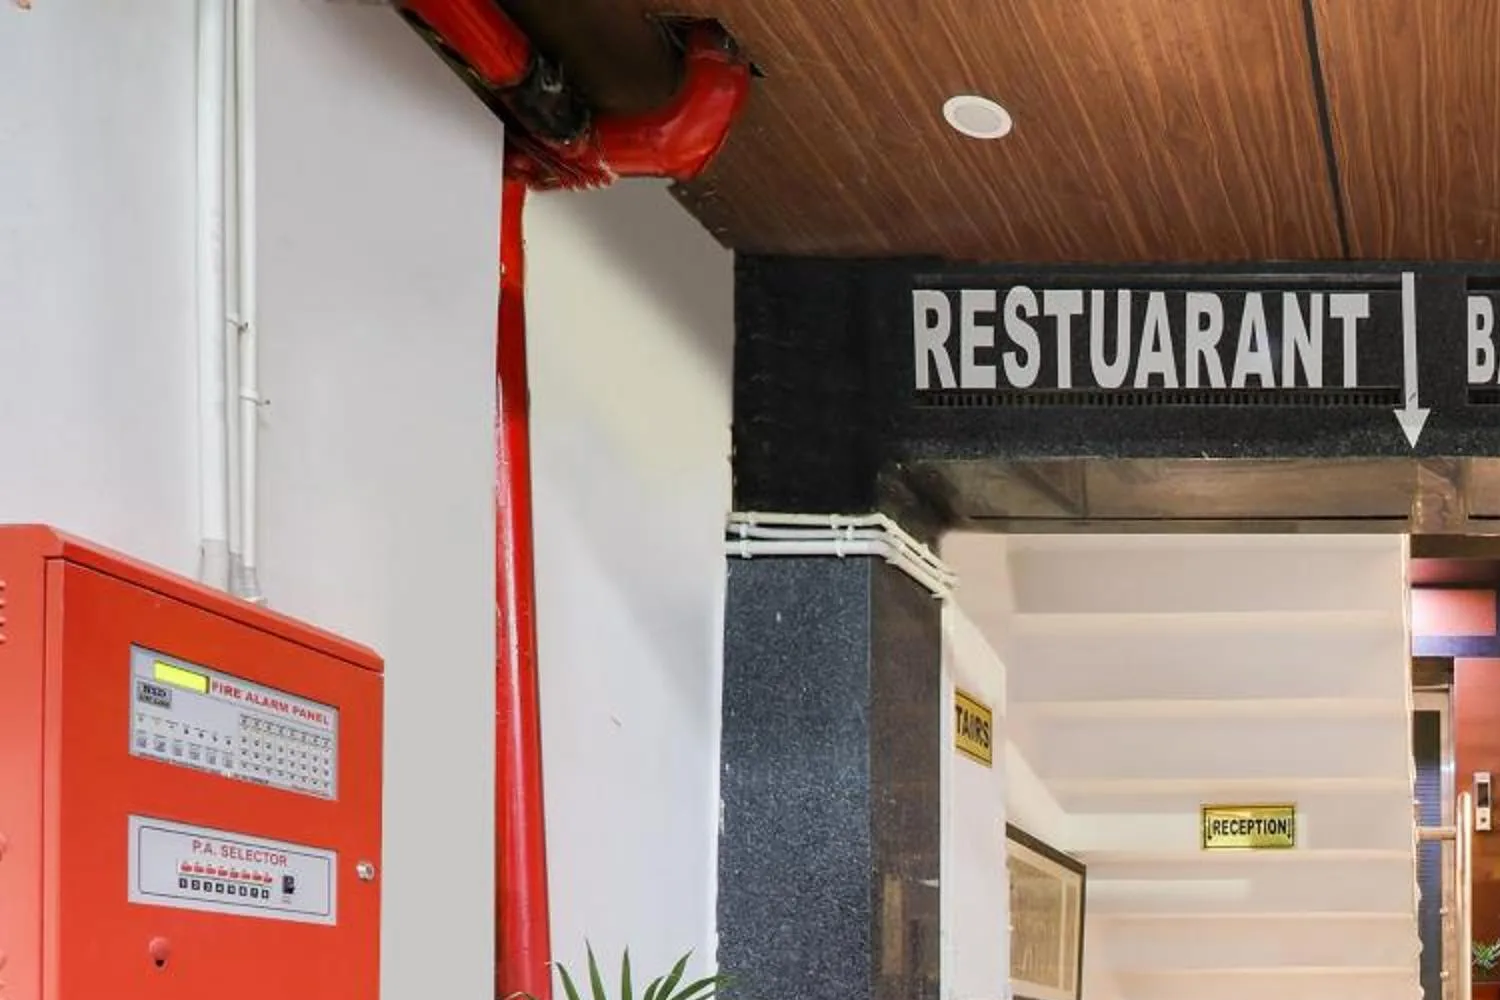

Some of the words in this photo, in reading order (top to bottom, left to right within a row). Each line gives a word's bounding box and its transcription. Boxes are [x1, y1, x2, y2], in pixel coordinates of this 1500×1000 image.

[912, 285, 1370, 389] RESTUARANT
[211, 681, 241, 699] FIRE
[245, 692, 289, 713] ALARM
[291, 705, 330, 726] PANEL
[1213, 819, 1287, 836] RECEPTION
[221, 844, 288, 867] SELECTOR
